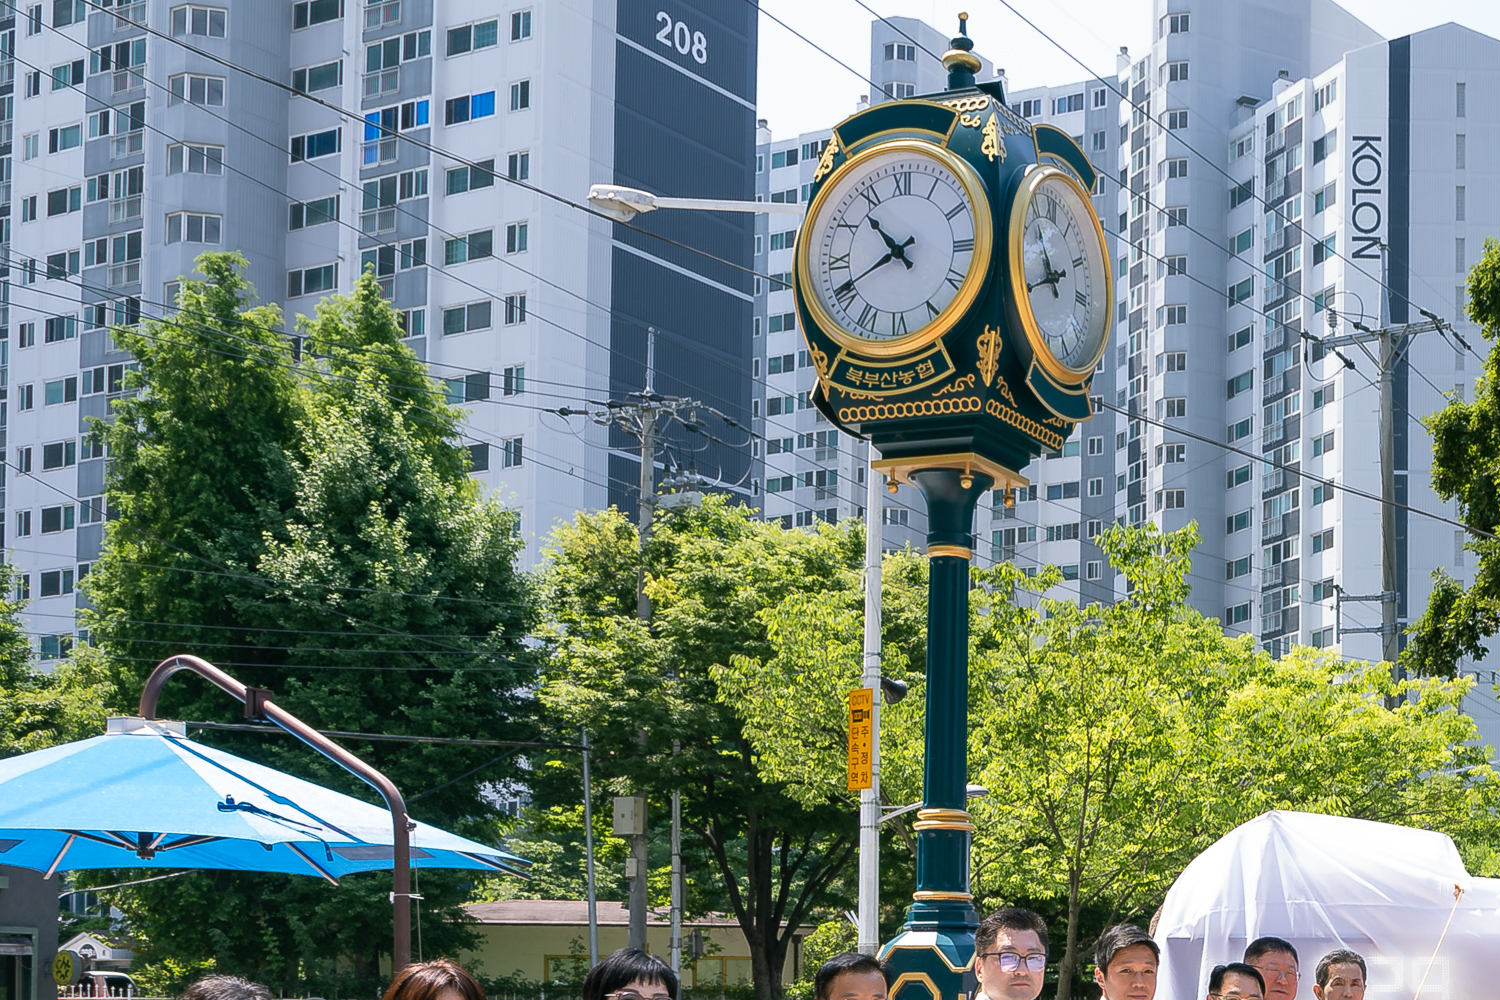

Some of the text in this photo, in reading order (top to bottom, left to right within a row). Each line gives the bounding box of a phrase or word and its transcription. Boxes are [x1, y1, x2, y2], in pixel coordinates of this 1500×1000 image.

[656, 11, 707, 64] 208
[1352, 136, 1382, 259] KOLON
[846, 360, 935, 388] 북부산농협
[852, 695, 869, 706] CCTV
[851, 727, 860, 784] 단속구역
